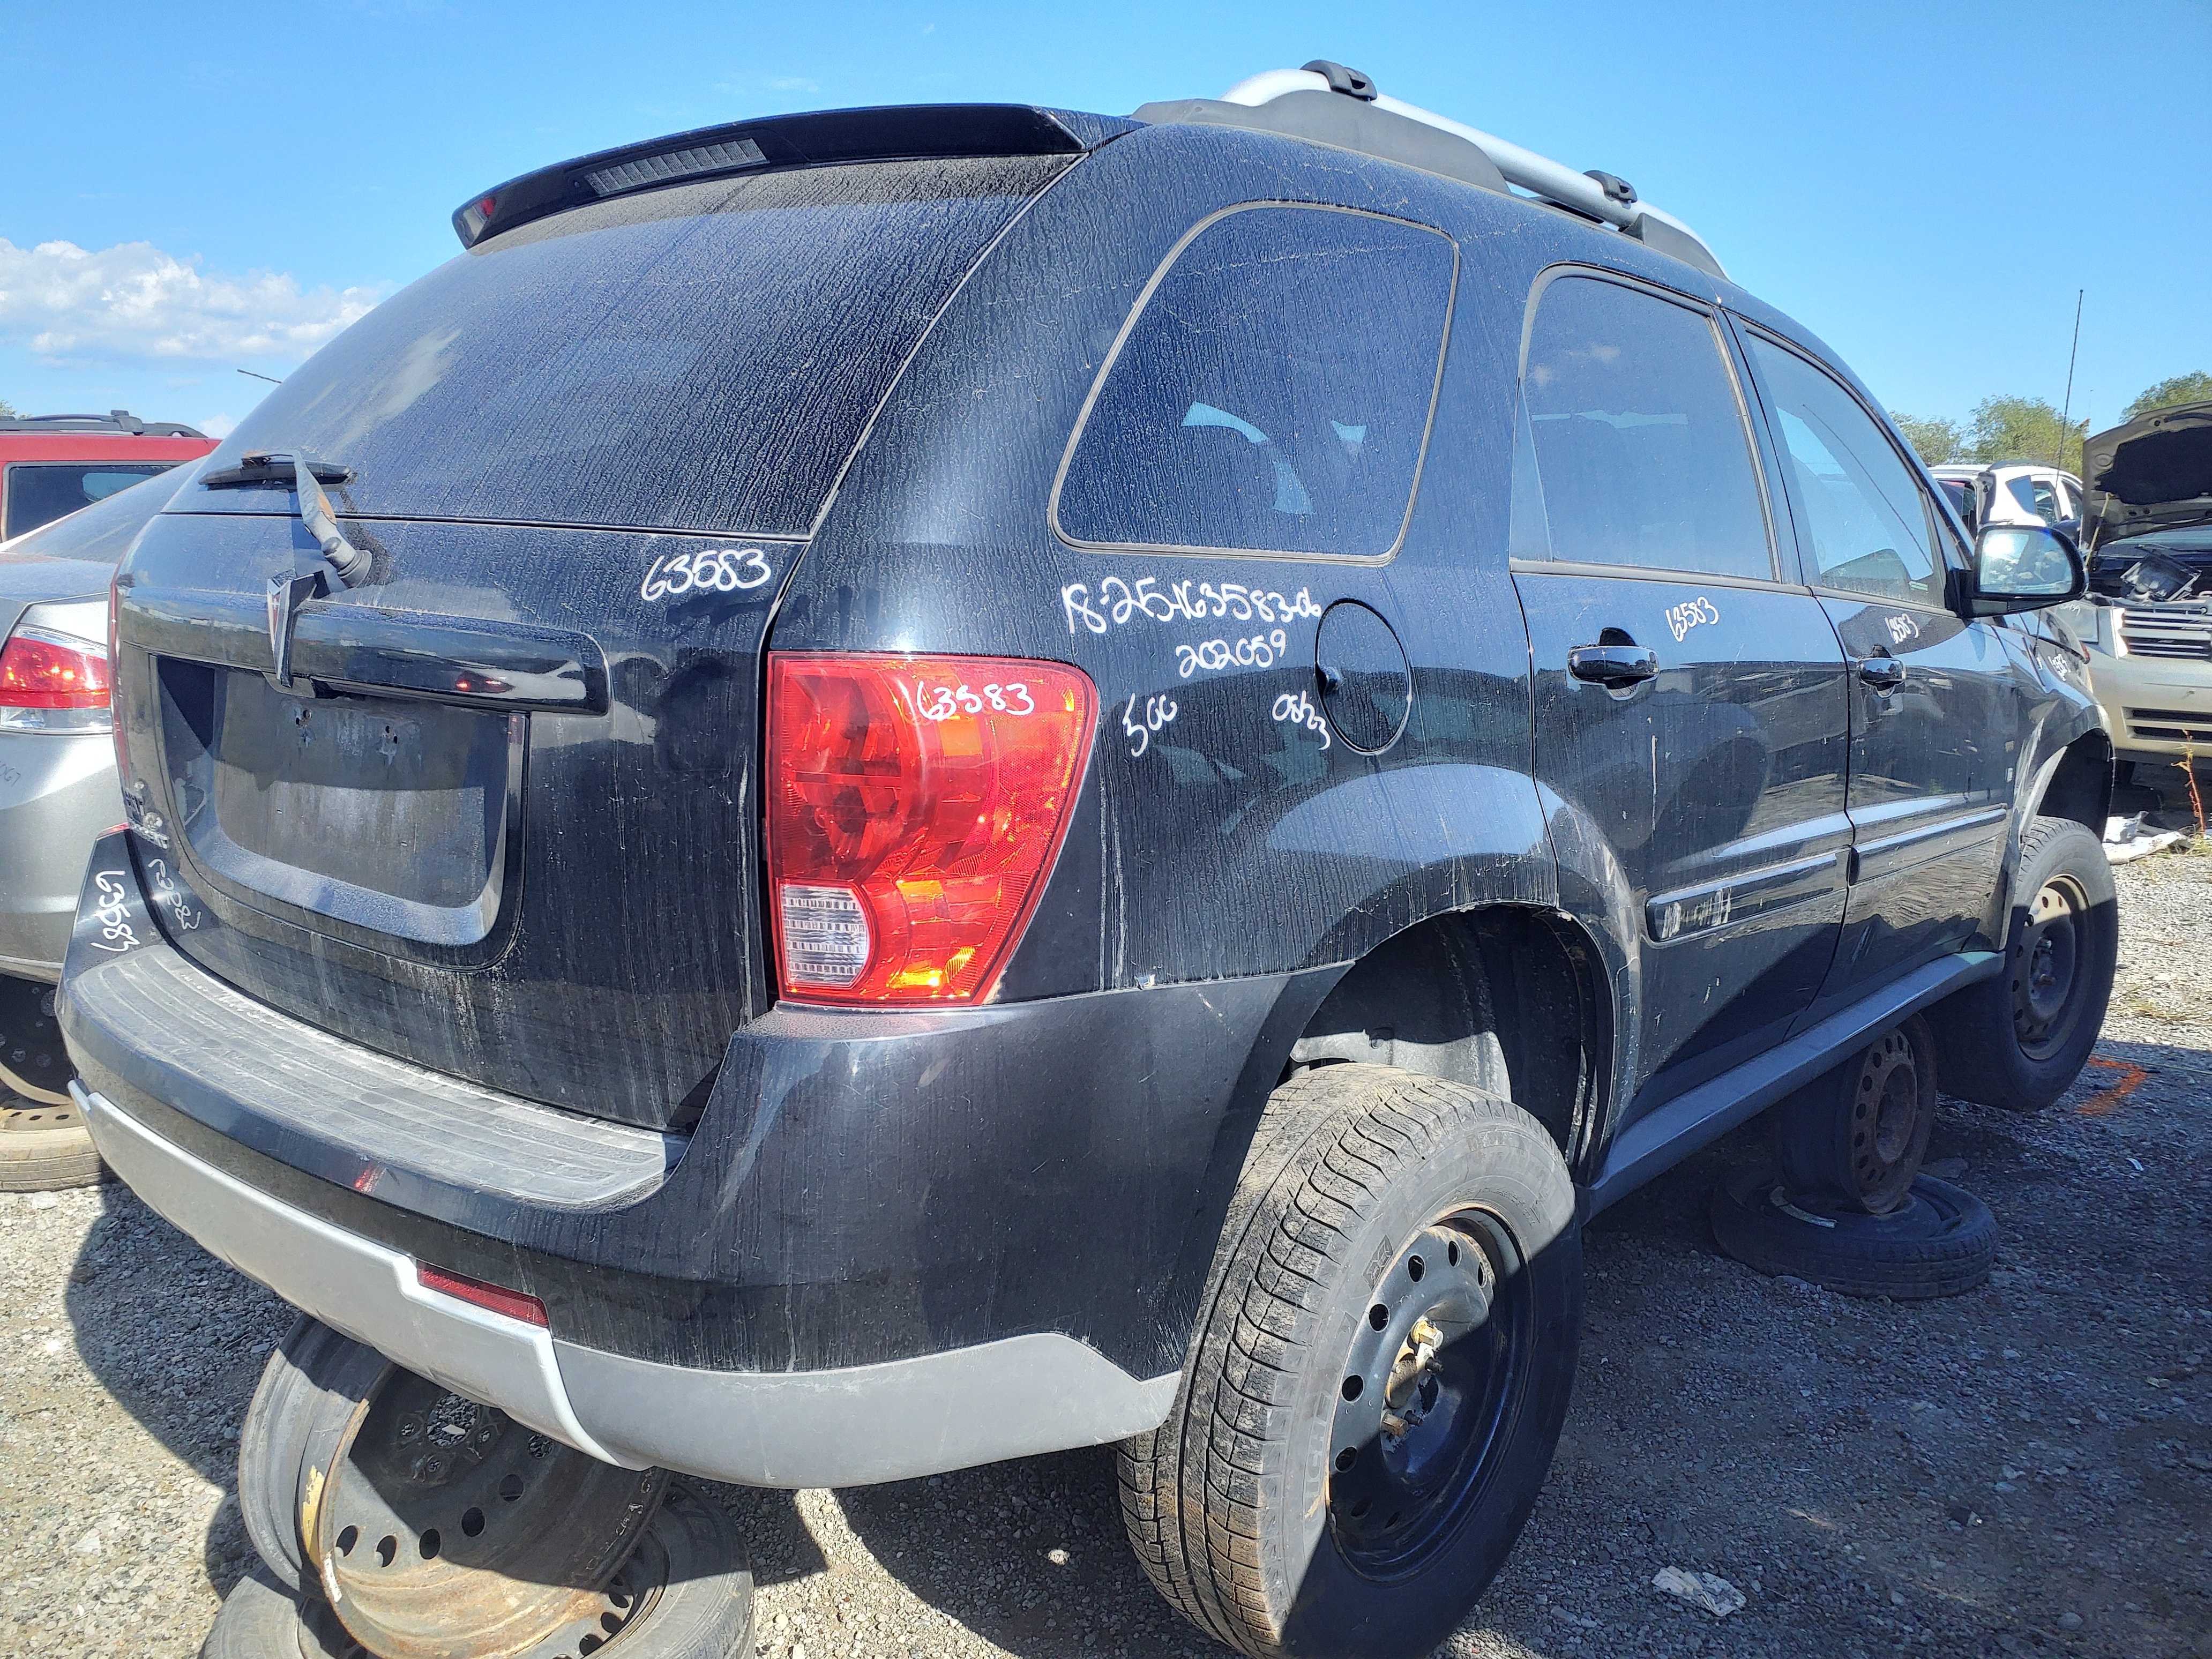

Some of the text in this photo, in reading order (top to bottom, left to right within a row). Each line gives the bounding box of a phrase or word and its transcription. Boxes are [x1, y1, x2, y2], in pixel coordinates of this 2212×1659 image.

[641, 549, 771, 601] 63583
[1665, 596, 1719, 642] 63583
[1176, 629, 1286, 678] 202059
[917, 681, 1035, 720] 63583
[90, 870, 140, 952] 63583
